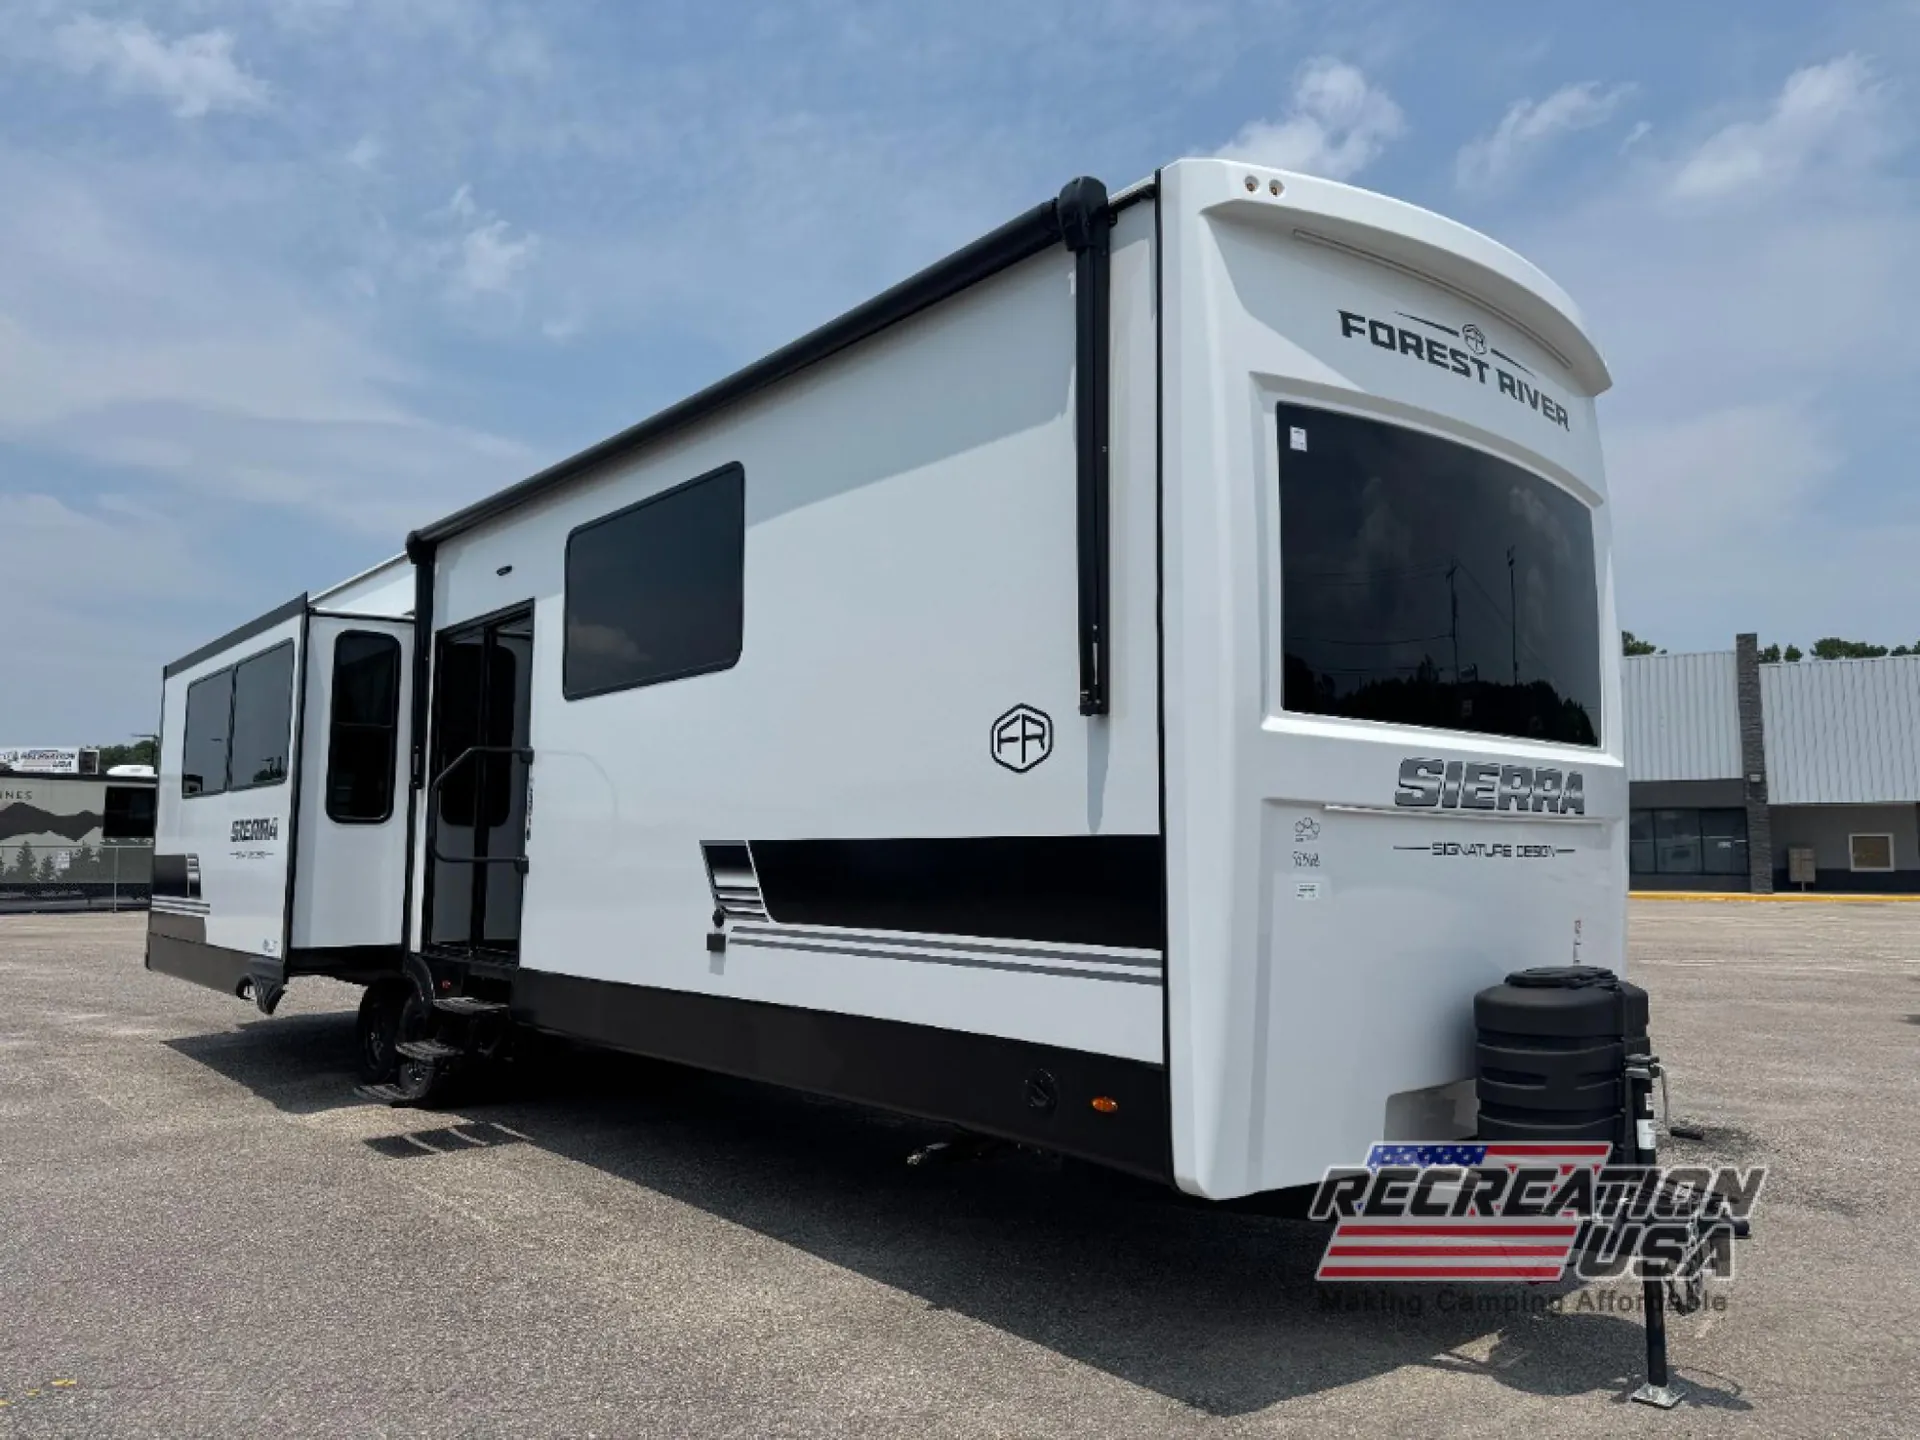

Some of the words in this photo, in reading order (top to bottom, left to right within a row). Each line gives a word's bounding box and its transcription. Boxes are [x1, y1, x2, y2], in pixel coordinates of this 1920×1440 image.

[1337, 309, 1490, 384] FOREST
[1496, 368, 1570, 432] RIVER
[1395, 757, 1585, 815] SIERRA
[230, 817, 278, 842] SIERRA
[1432, 842, 1512, 858] SIGNATURE
